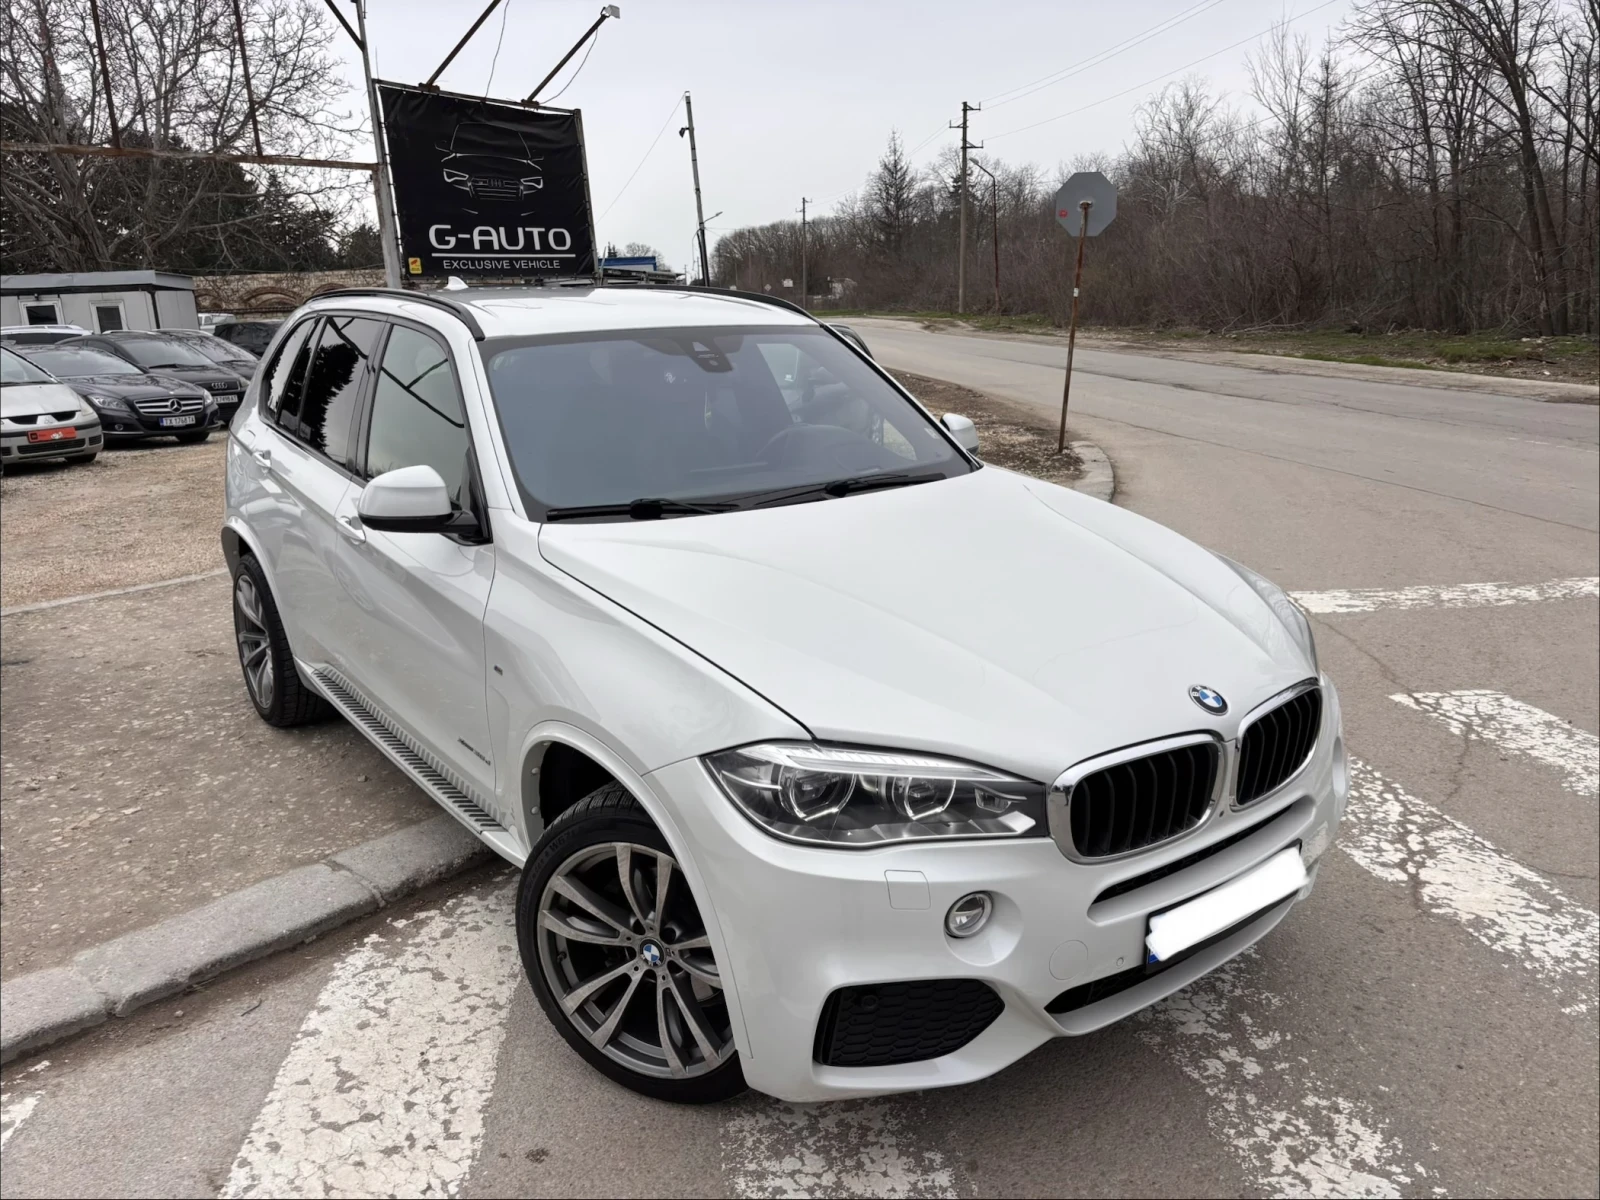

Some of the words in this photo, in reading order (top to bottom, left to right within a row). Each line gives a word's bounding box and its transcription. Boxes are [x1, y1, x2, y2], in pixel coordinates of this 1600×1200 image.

[429, 224, 572, 251] G-AUTO
[443, 260, 511, 269] EXCLUSIVE
[513, 260, 561, 269] VEHICLE
